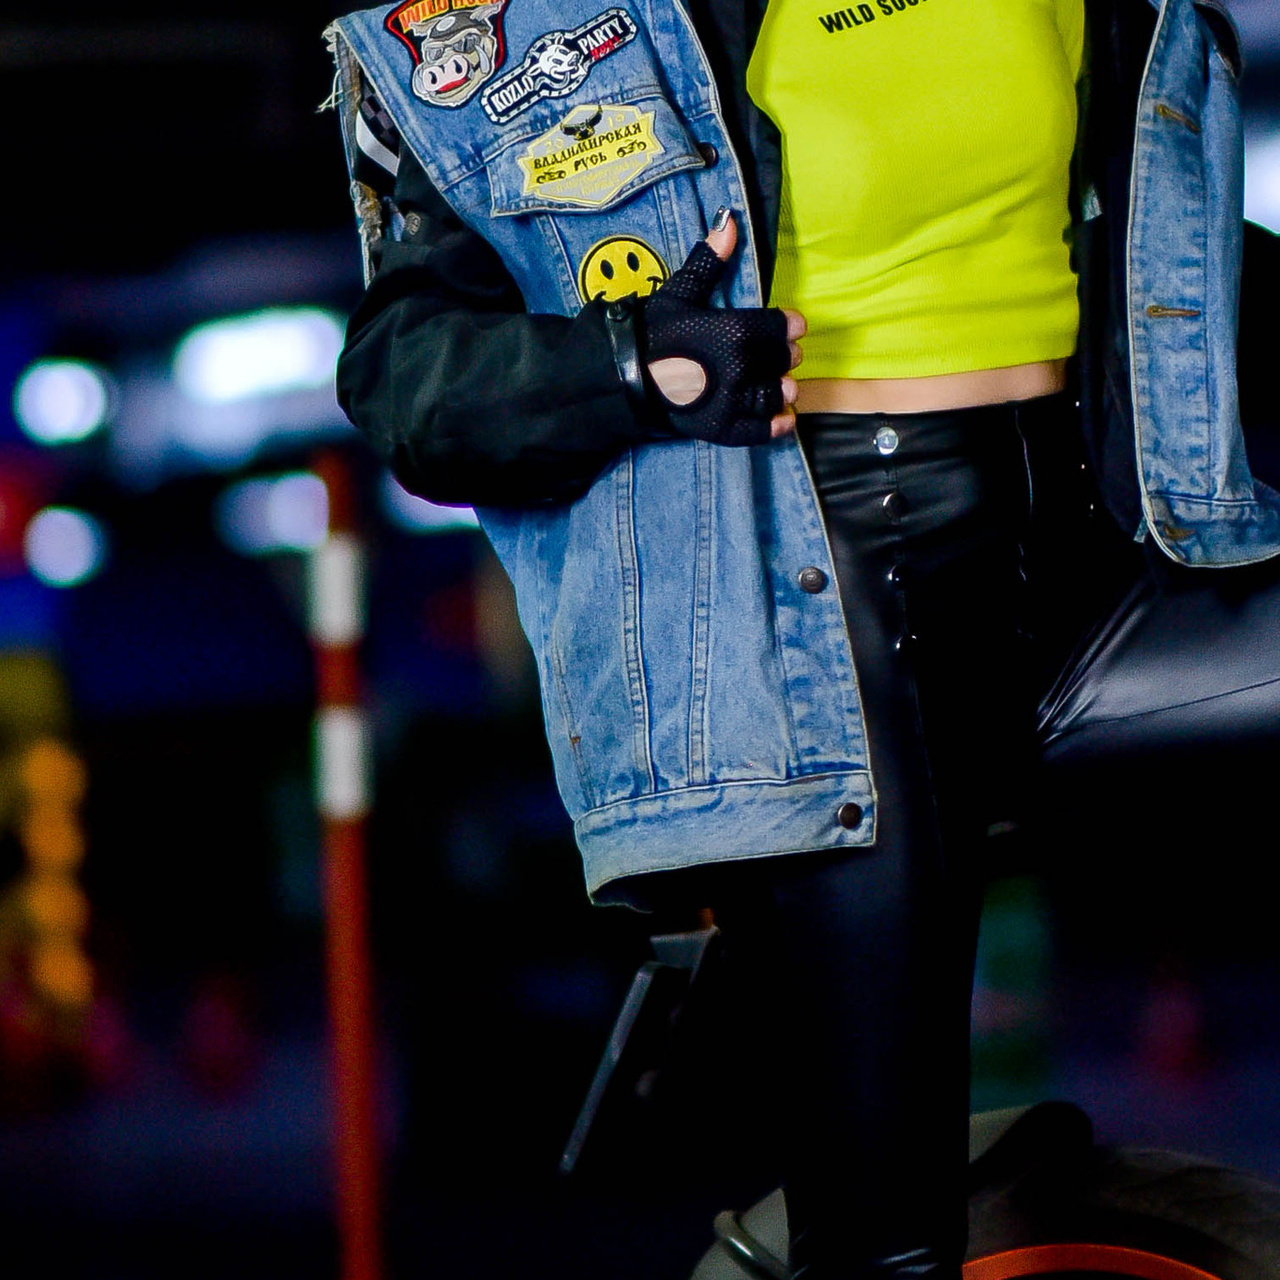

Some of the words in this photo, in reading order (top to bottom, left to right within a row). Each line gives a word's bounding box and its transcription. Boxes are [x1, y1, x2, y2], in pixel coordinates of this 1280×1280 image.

[818, 3, 876, 34] WILD
[491, 73, 536, 112] KOZLO
[578, 18, 625, 55] PARTY
[532, 121, 643, 170] ВЛАДИМИРСКАЯ
[573, 151, 608, 173] РУСЬ
